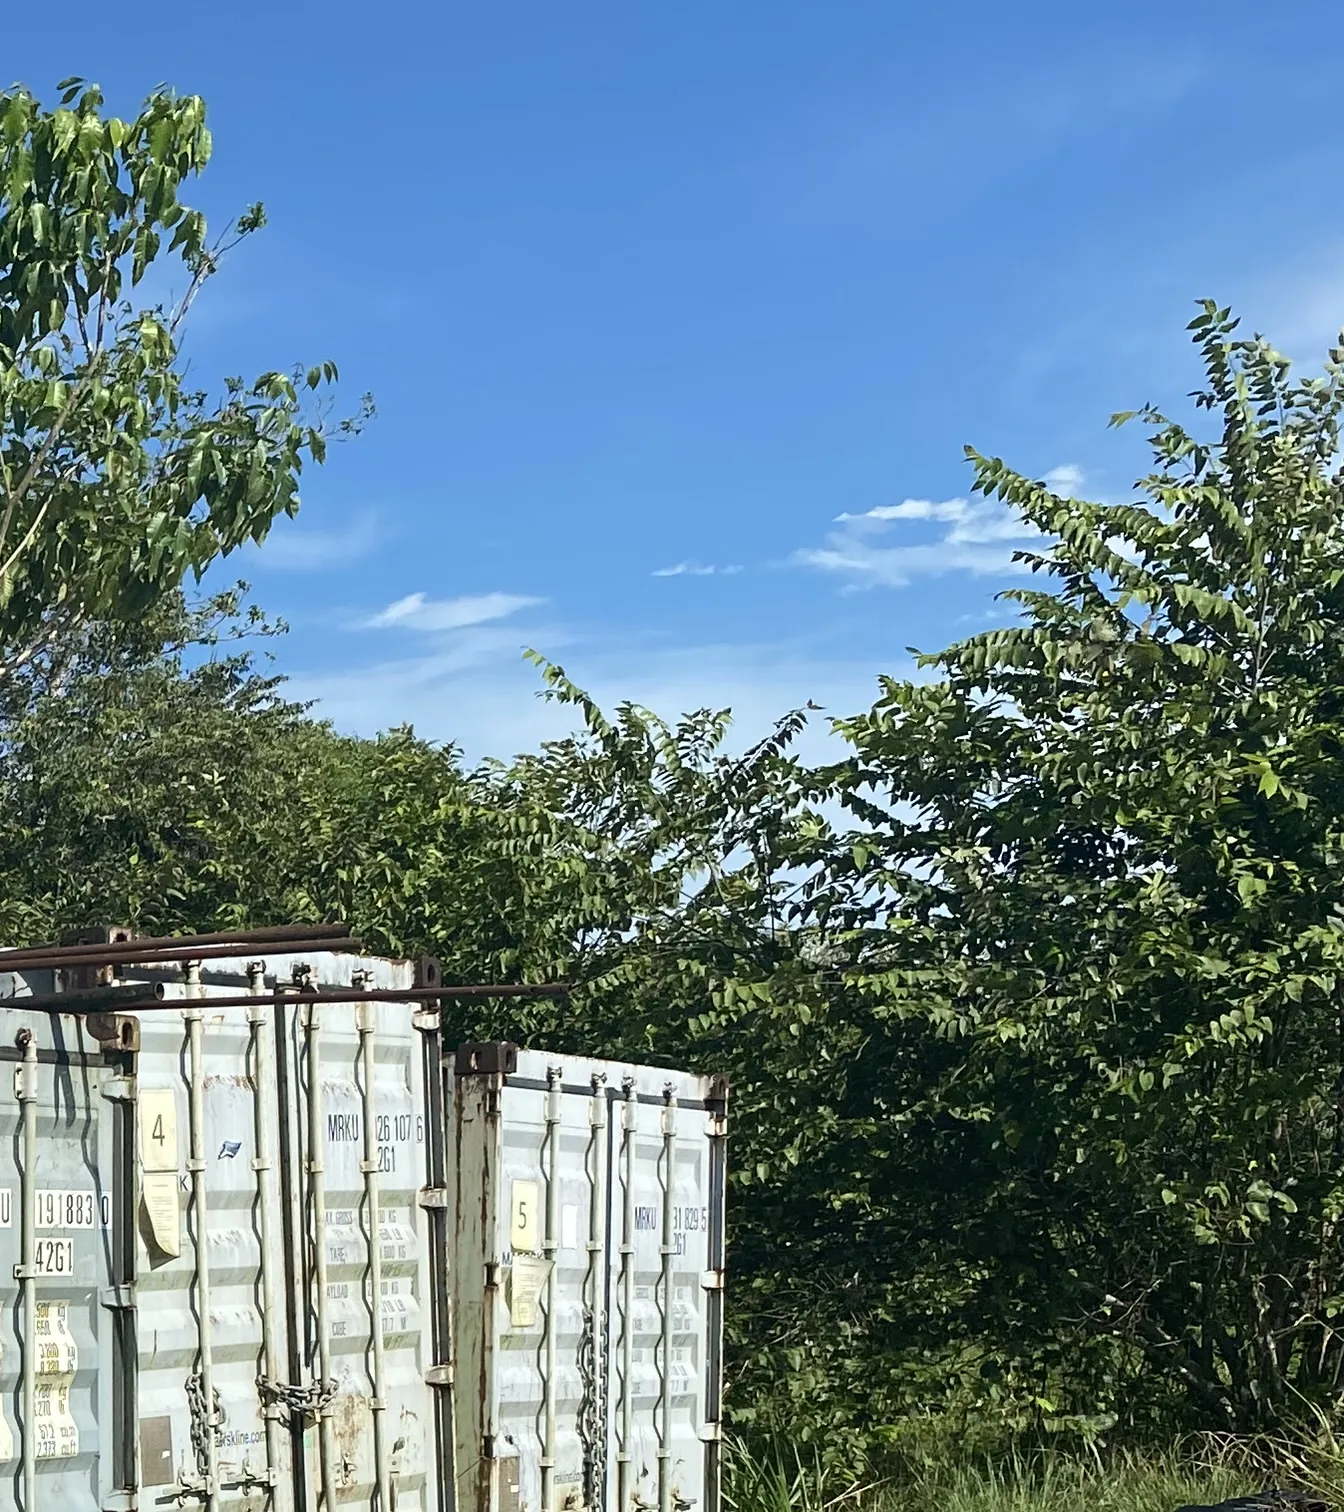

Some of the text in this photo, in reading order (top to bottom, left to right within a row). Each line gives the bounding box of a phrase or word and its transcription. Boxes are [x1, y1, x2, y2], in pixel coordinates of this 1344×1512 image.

[152, 1113, 165, 1147] 4
[328, 1114, 358, 1141] MRKU
[376, 1115, 390, 1141] 26
[394, 1115, 411, 1141] 107
[378, 1146, 395, 1172] 2G1
[38, 1193, 93, 1225] 191883
[518, 1202, 527, 1229] 5
[36, 1241, 72, 1272] 42G1
